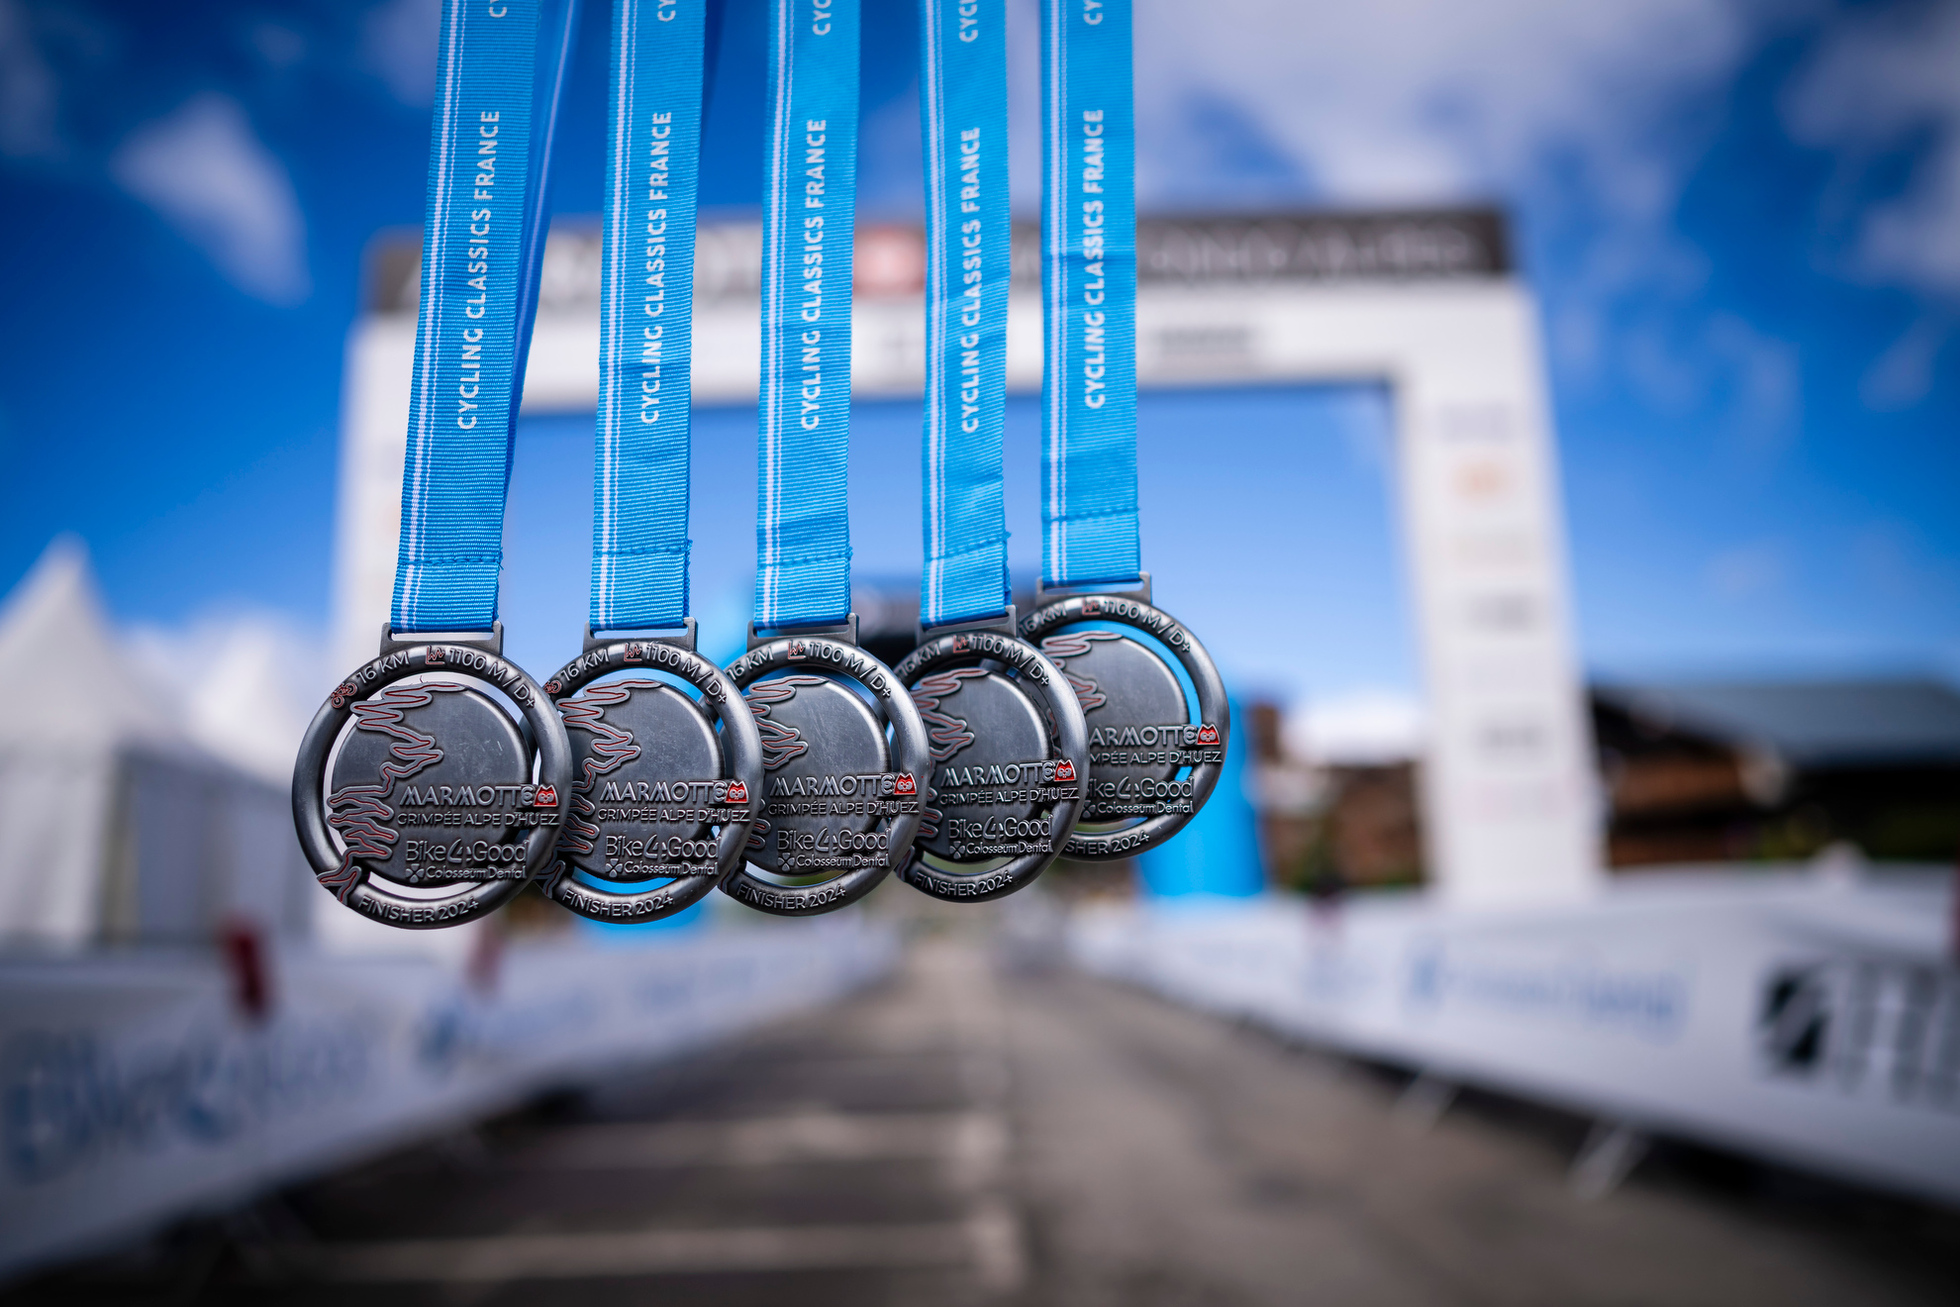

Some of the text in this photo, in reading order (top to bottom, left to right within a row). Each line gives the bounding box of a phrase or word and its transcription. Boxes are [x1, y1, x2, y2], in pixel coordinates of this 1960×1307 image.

[458, 110, 500, 429] CYCLING CLASSICS FRANCE
[641, 111, 672, 423] CYCLING CLASSICS FRANCE
[1082, 109, 1105, 409] CYCLING CLASSICS FRANCE
[801, 119, 827, 430] CYCLING CLASSICS FRANCE
[961, 127, 982, 433] CYCLING CLASSICS FRANCE
[1020, 603, 1066, 635] 16 KM
[1104, 600, 1140, 618] 1100
[808, 642, 844, 663] 1100
[972, 636, 1004, 654] 1100
[356, 650, 410, 684] 16 KM
[450, 649, 486, 670] 1100
[560, 648, 610, 682] 16 KM
[646, 646, 681, 668] 1100
[728, 646, 773, 680] 16 KM
[898, 643, 940, 676] 16 KM
[1090, 725, 1198, 746] ARMOTTE
[1130, 752, 1166, 764] ALPE
[1170, 751, 1222, 763] D'HUEZ
[939, 786, 1080, 805] GRIMPÉE ALPE D'HUEZ
[1087, 776, 1194, 799] ike4Good
[397, 811, 560, 826] GRIMPÉE ALPE D'HUEZ
[598, 805, 750, 823] GRIMPÉE ALPE D'HUEZ
[768, 799, 919, 816] GRIMPÉE ALPE D'HUEZ
[1097, 801, 1194, 814] Colosseum Dental
[966, 839, 1052, 855] Colosseum Dental
[1066, 830, 1150, 854] SHER 2024
[624, 860, 719, 876] Colosseum Dental
[796, 852, 890, 868] Colosseum Dental
[426, 864, 527, 879] Colosseum Dental
[913, 871, 1014, 896] FINISHER 2024
[562, 890, 674, 917] FINISHER 2024
[736, 883, 847, 910] FINISHER 2024
[358, 896, 479, 923] FINISHER 2024
